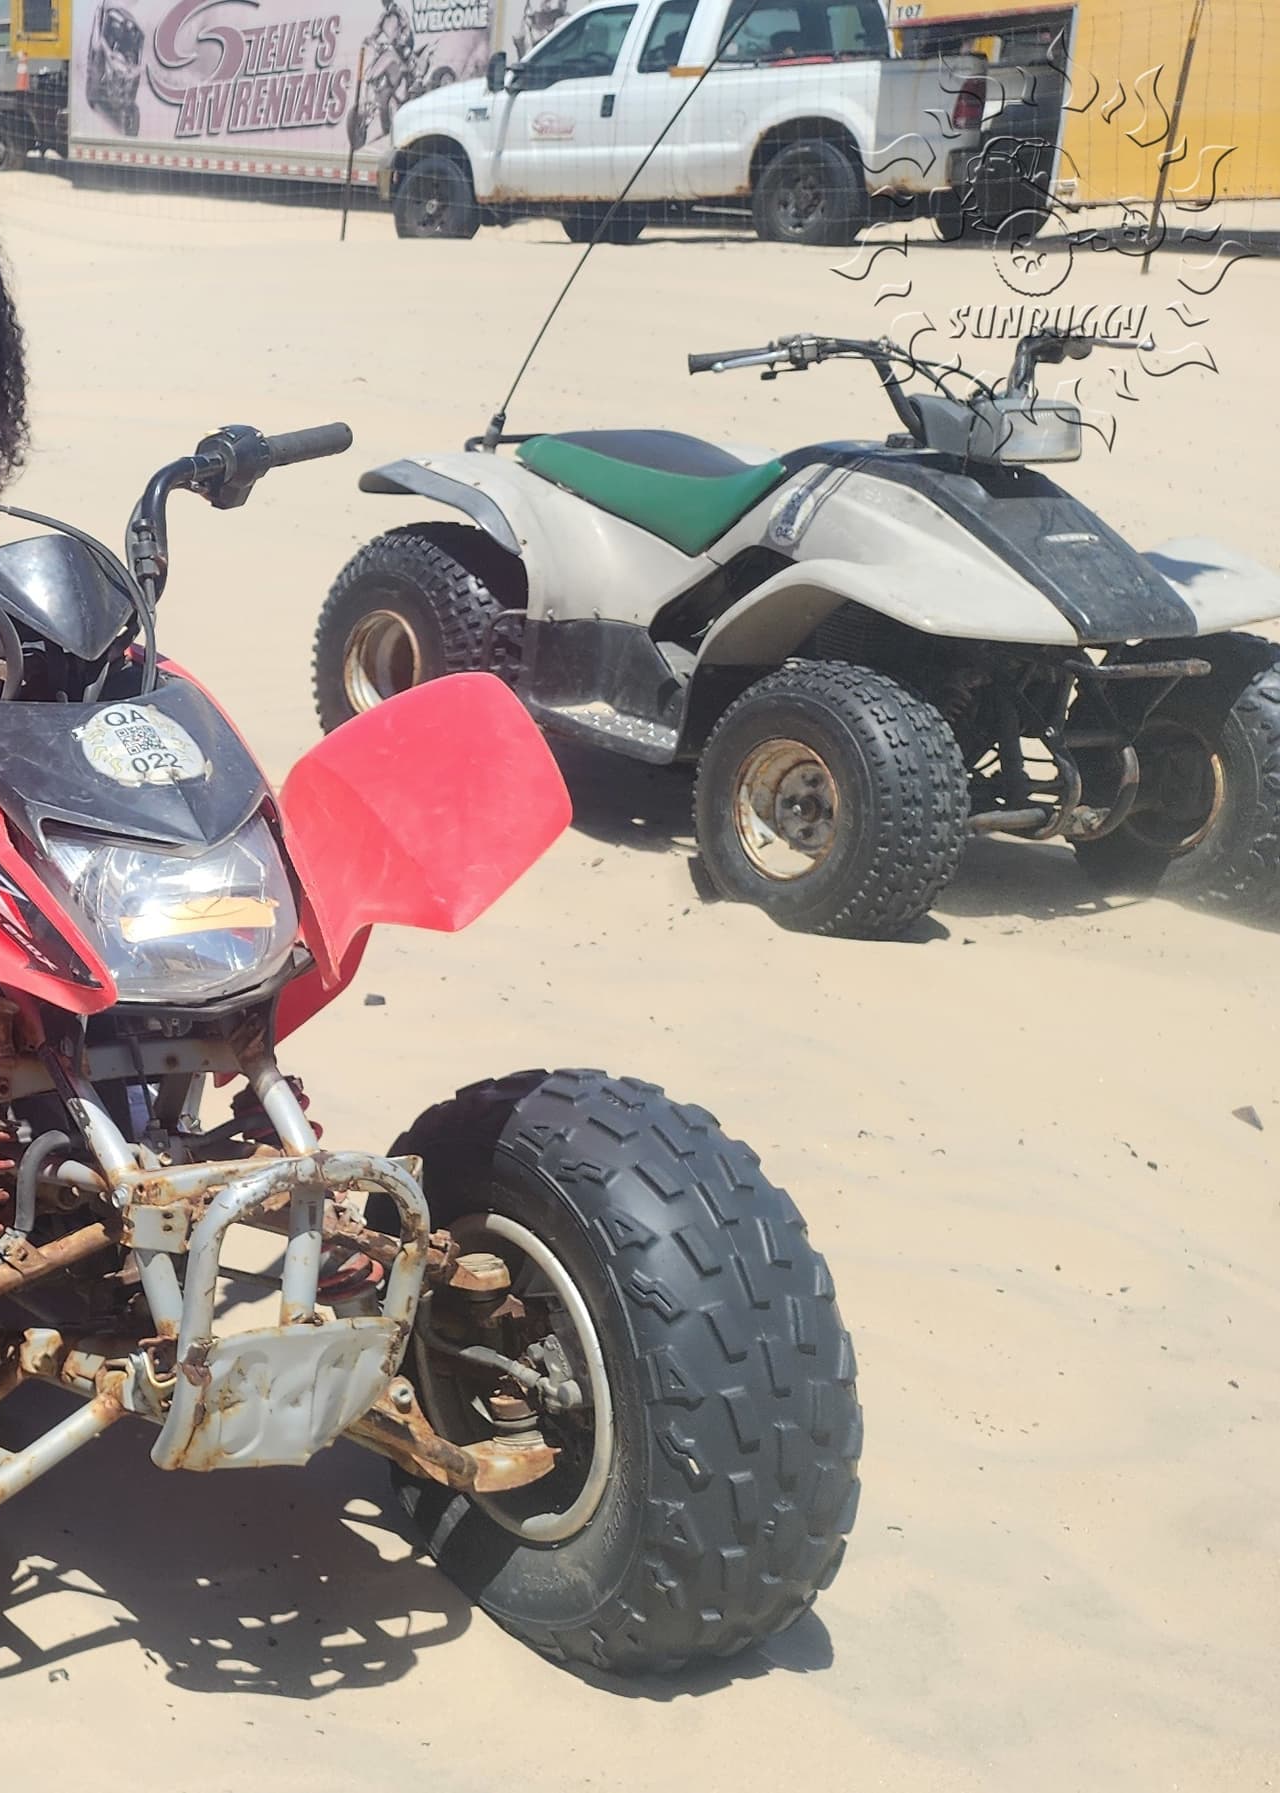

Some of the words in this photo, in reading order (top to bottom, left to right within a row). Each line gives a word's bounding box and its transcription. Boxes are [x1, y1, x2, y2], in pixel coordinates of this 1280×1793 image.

[414, 6, 488, 33] WELCOME
[147, 0, 340, 102] STEVE'S
[175, 80, 230, 137] ATV
[228, 68, 352, 133] RENTALS
[104, 709, 149, 727] QA
[132, 752, 183, 774] 022
